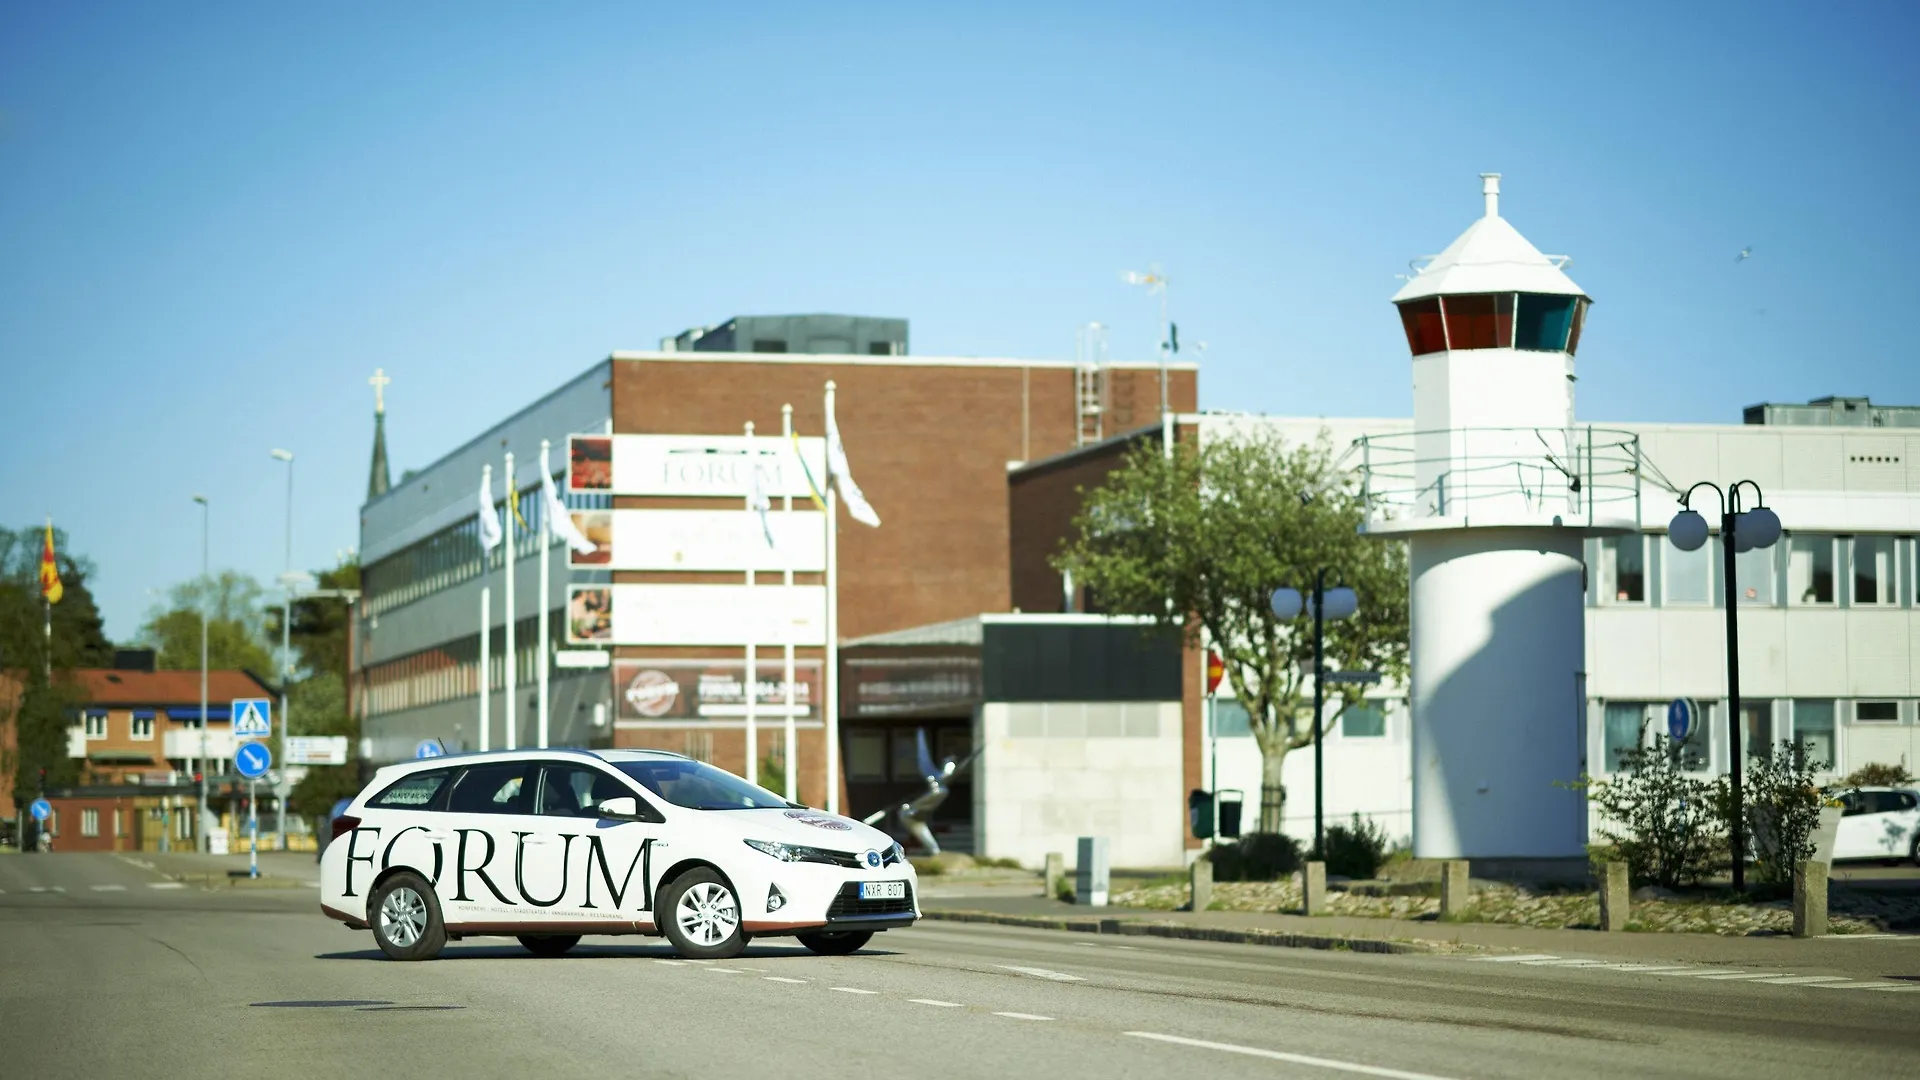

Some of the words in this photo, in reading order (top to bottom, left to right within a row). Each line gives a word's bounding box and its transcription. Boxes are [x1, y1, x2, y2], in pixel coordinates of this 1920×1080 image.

[341, 825, 658, 912] FORUM
[865, 884, 882, 897] NXR
[888, 884, 903, 896] 807
